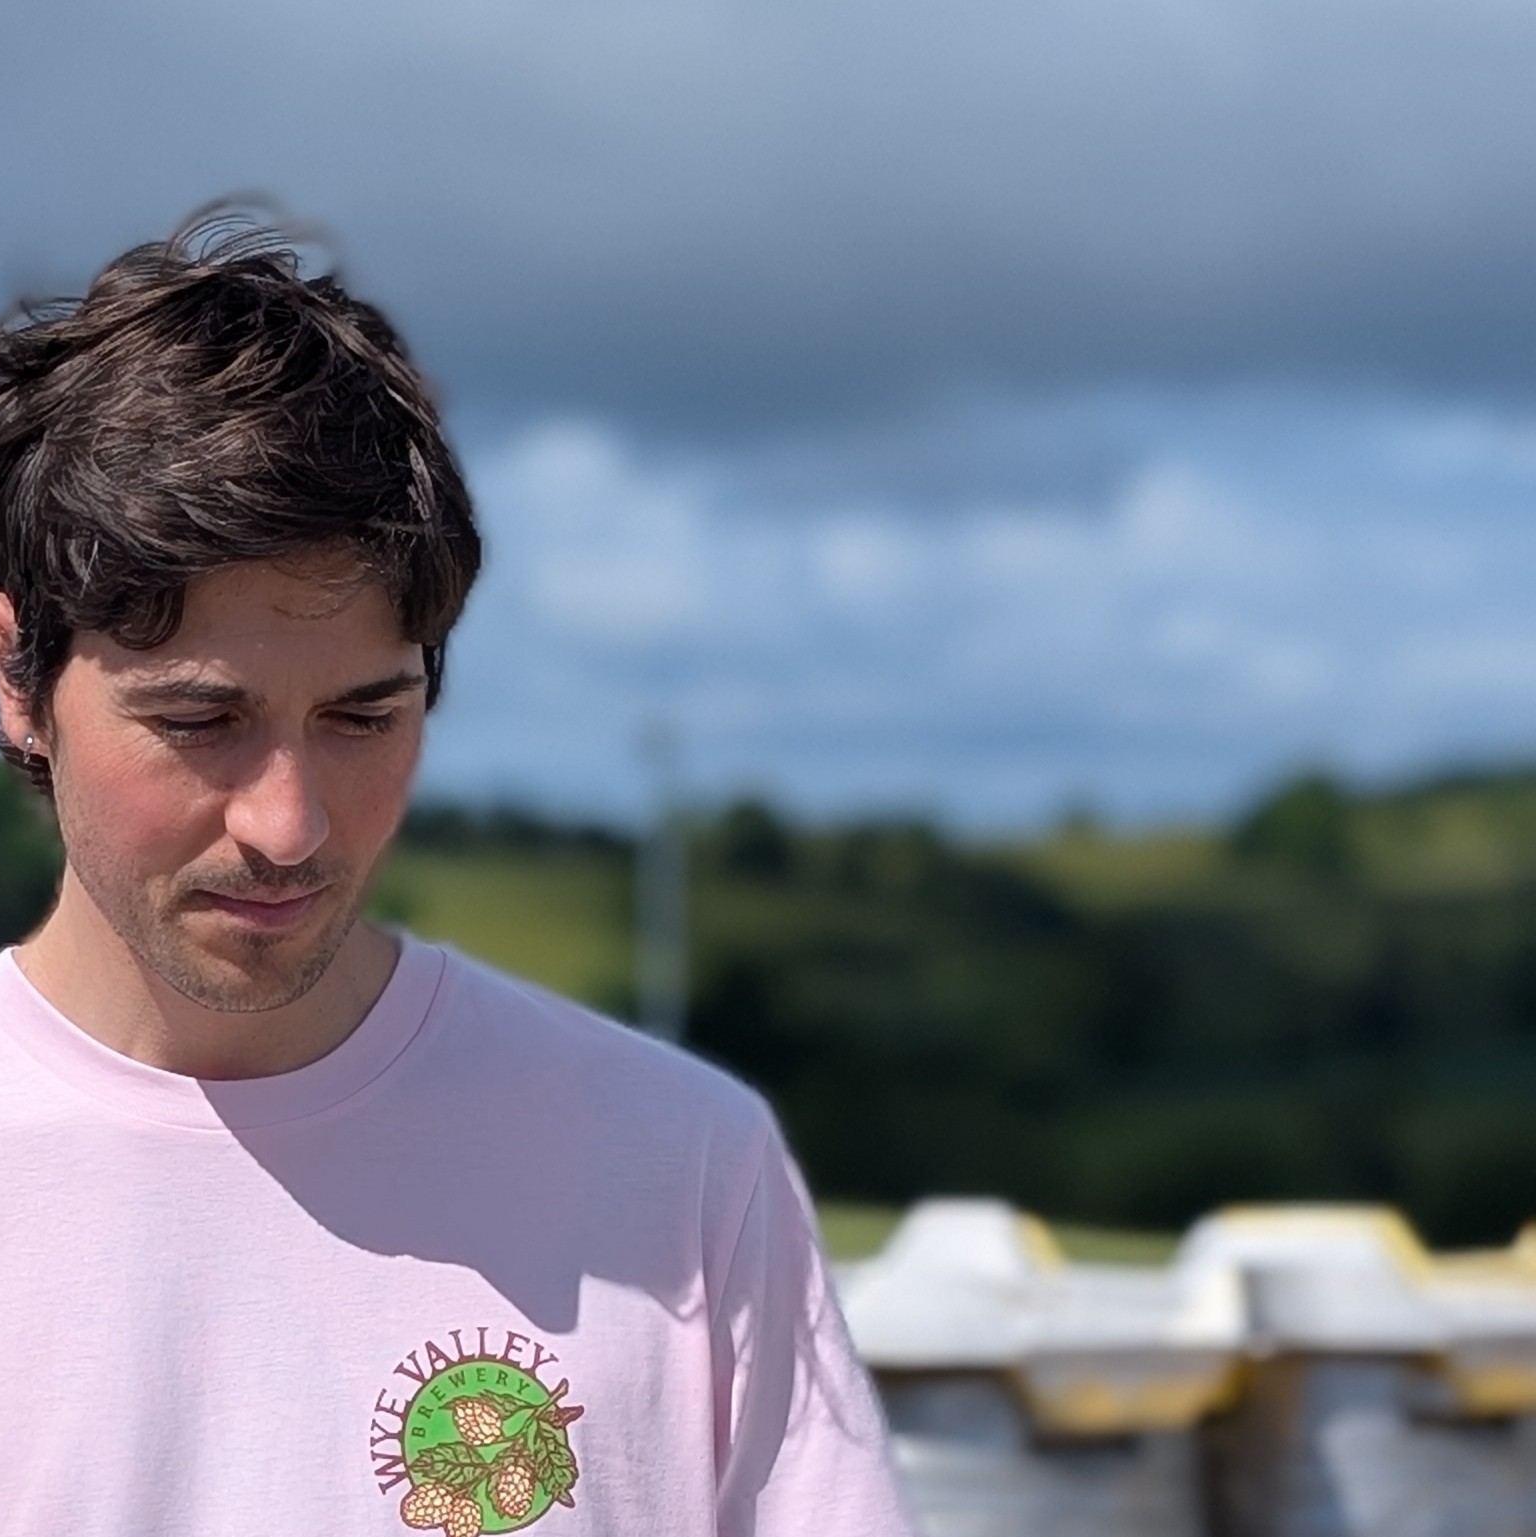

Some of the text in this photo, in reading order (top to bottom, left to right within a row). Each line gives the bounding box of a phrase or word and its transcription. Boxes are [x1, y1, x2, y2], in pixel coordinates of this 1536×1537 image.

[371, 1328, 559, 1495] WYE VALLEY
[412, 1368, 530, 1438] BREWERY
